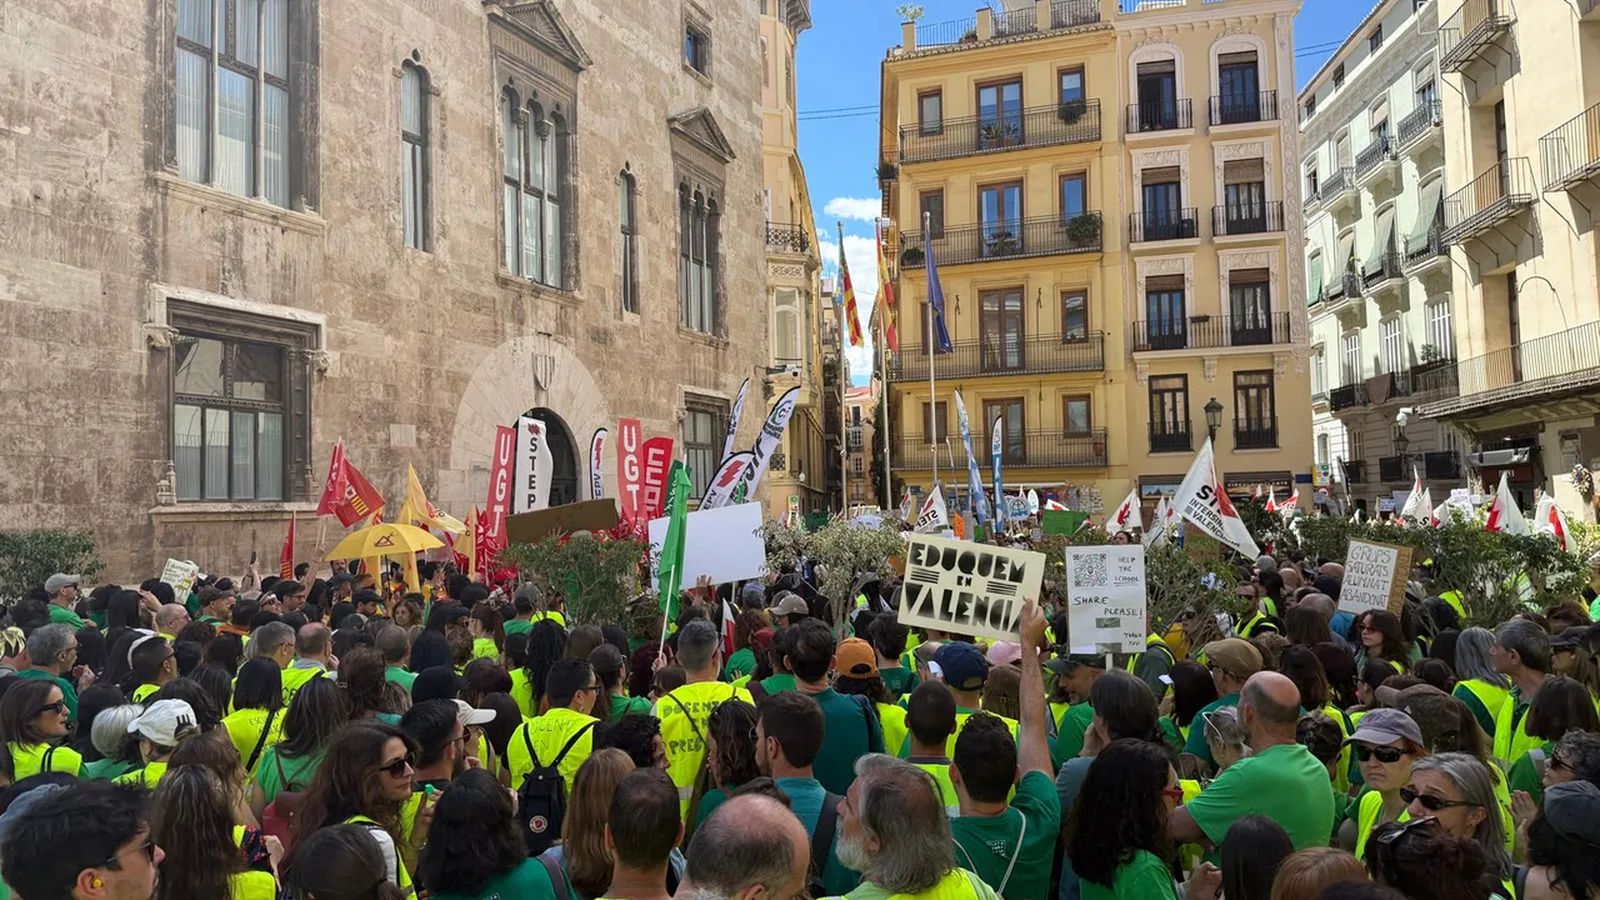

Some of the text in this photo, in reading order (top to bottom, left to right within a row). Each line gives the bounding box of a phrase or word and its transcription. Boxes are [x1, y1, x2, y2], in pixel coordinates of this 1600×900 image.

[487, 433, 511, 537] UGT
[527, 437, 538, 509] STEP
[624, 425, 640, 511] UGT
[910, 542, 1026, 583] EDUQUEM
[956, 576, 973, 587] EN
[1072, 596, 1109, 605] SHARE
[1104, 607, 1143, 620] PLEASE!
